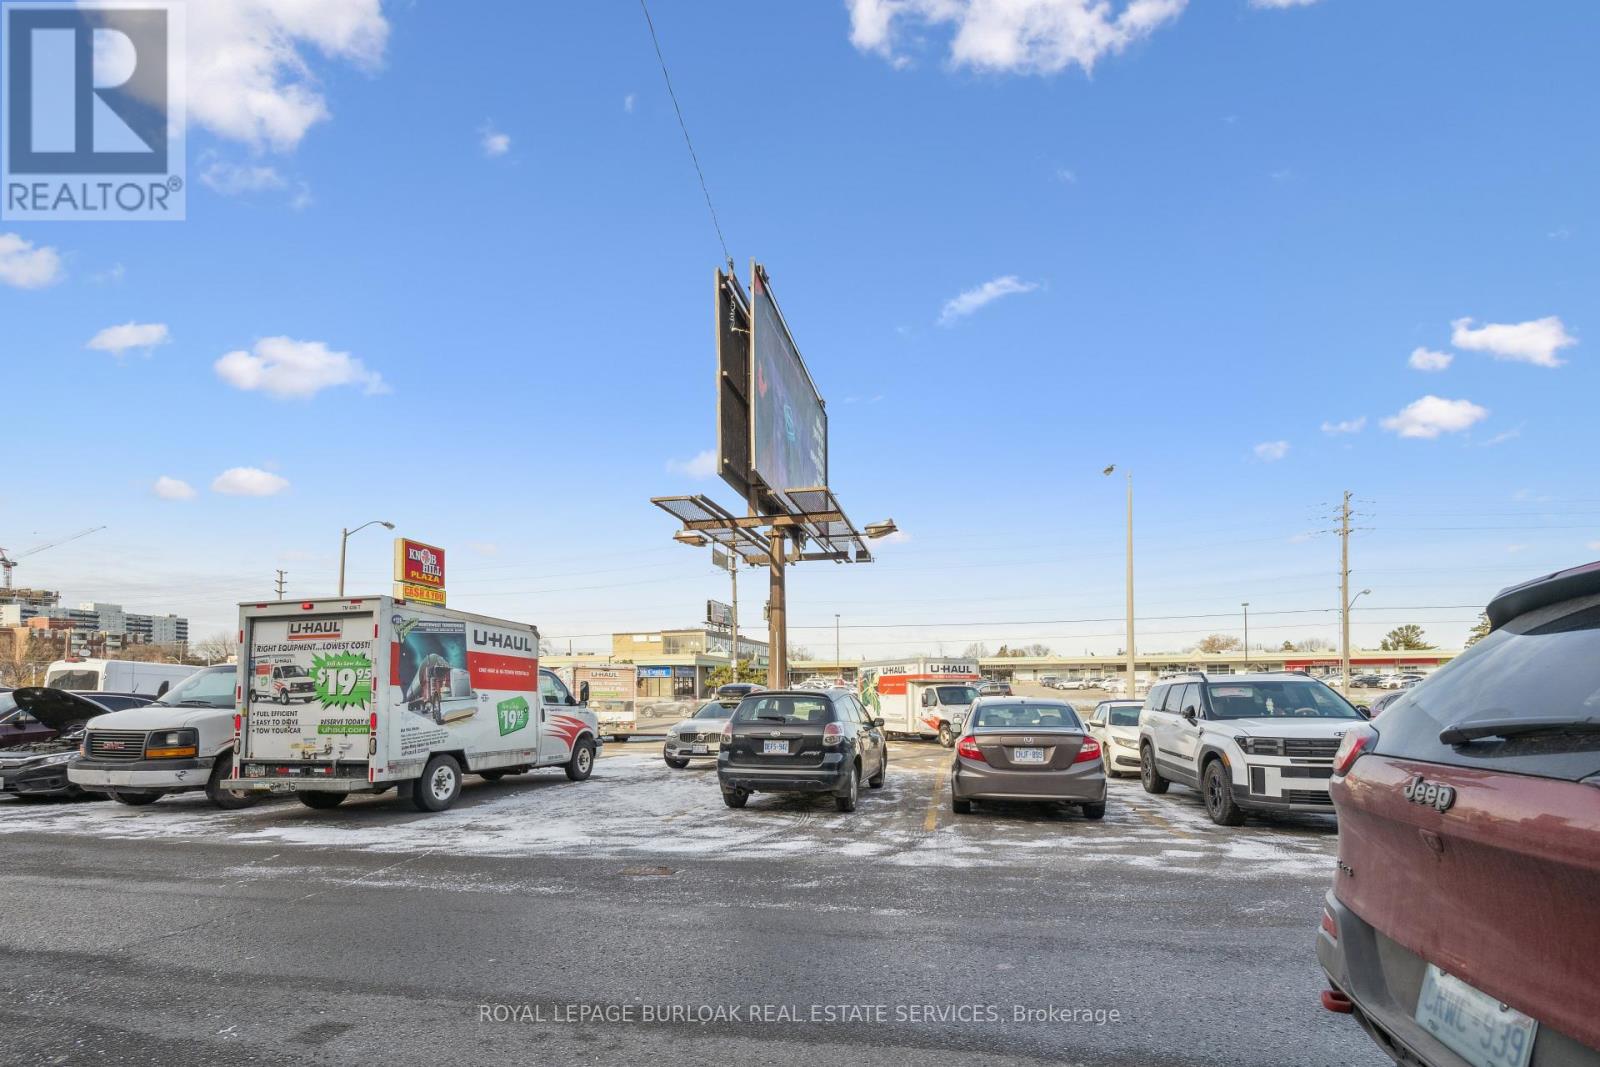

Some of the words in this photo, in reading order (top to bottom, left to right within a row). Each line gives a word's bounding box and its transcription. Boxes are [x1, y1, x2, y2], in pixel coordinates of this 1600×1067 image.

[410, 570, 440, 583] PLAZA
[290, 621, 341, 634] U-HAUL
[256, 644, 278, 653] RIGHT
[350, 640, 371, 650] COST!
[473, 629, 532, 652] U-HAUL
[882, 665, 907, 675] U-HAUL
[930, 664, 973, 674] U-HAUL
[320, 718, 343, 726] RESERVE
[1403, 775, 1457, 813] Jeep
